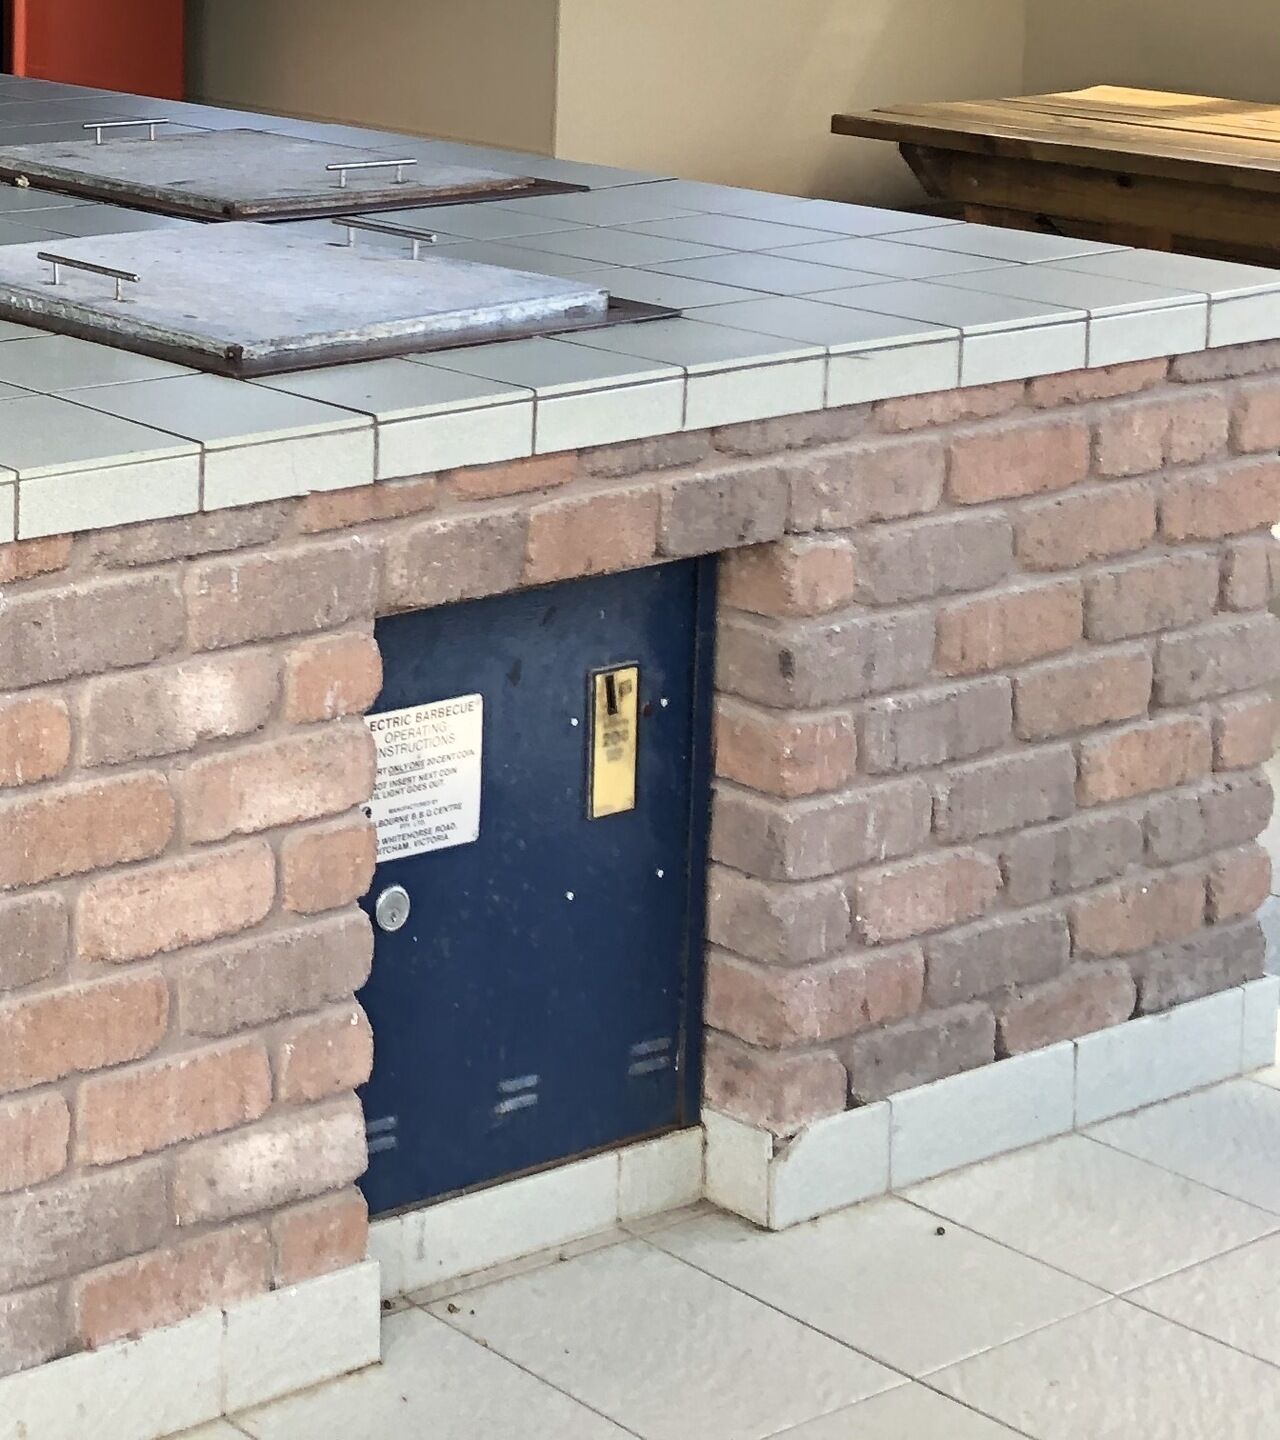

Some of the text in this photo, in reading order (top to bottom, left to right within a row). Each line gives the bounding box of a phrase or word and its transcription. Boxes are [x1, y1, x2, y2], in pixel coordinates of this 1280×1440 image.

[415, 701, 476, 723] BARBECUE
[384, 720, 448, 744] OPERATING
[390, 775, 416, 787] INSERT
[418, 769, 438, 781] NEXT
[382, 787, 405, 800] LIGHT
[406, 782, 427, 794] GOES
[433, 802, 463, 816] CENTRE
[381, 828, 433, 845] WHITEHORSE
[413, 832, 449, 848] VICTORIA
